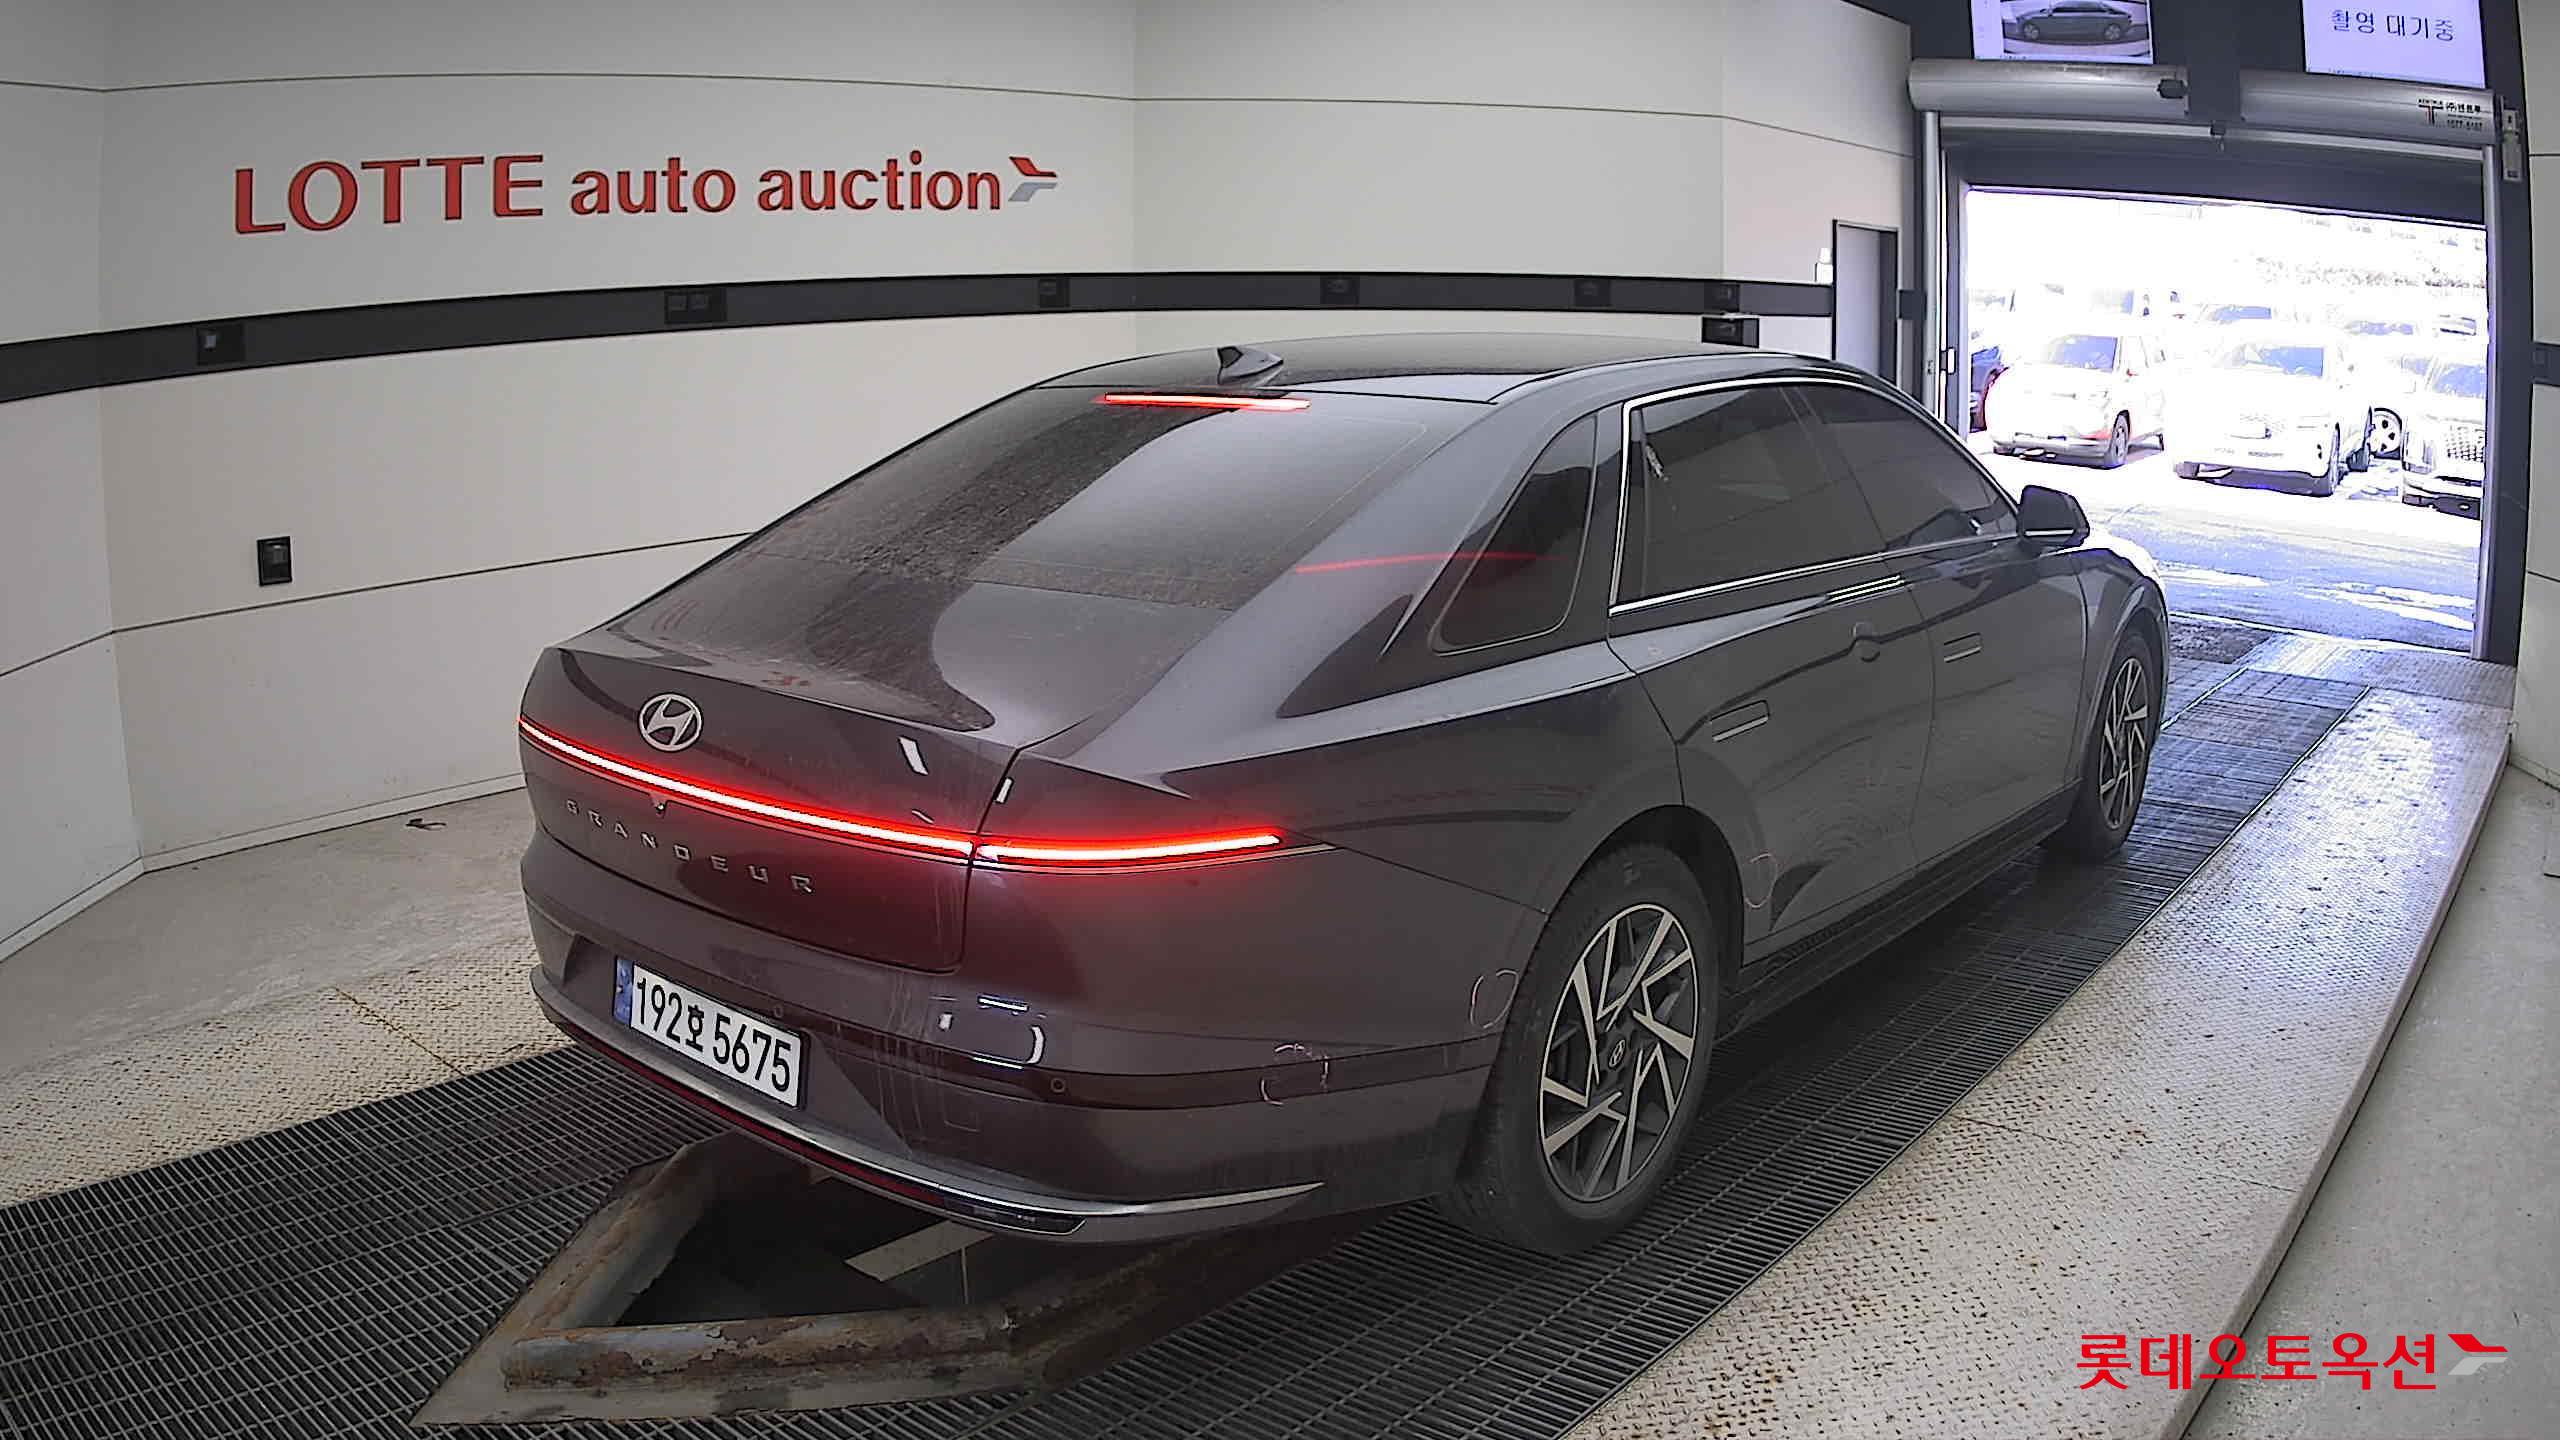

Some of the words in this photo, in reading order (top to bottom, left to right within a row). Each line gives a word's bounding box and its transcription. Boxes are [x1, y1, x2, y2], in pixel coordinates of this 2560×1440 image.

[2331, 10, 2376, 34] 촬영
[2386, 15, 2455, 42] 대기중
[236, 154, 543, 234] LOTTE
[570, 156, 736, 215] auto
[757, 150, 1003, 211] auction
[566, 800, 815, 893] GRANDEUR
[636, 977, 705, 1053] 192호
[712, 1012, 792, 1093] 5675
